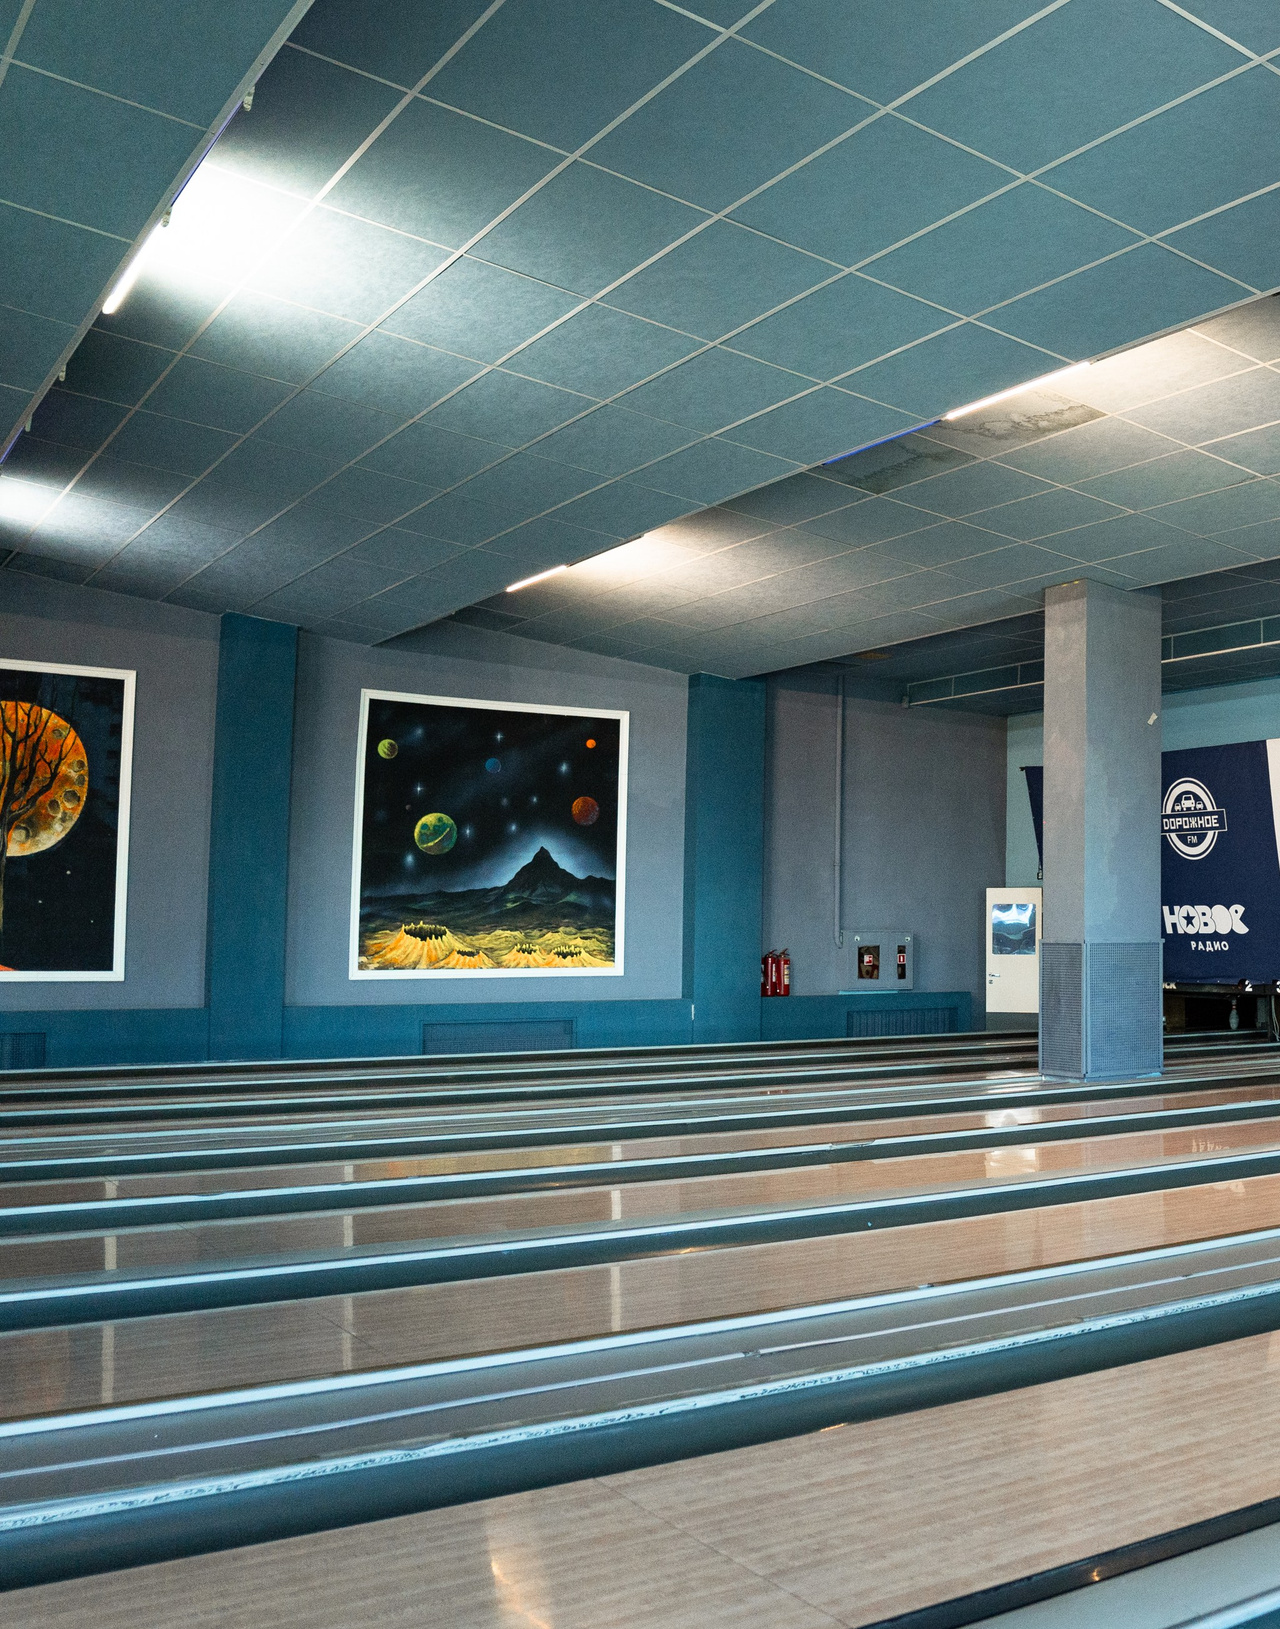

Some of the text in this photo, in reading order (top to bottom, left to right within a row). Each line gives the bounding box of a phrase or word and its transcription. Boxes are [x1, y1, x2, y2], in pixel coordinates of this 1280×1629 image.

[1187, 835, 1198, 844] FM
[1190, 940, 1230, 952] РАДИО
[1244, 980, 1253, 992] 2
